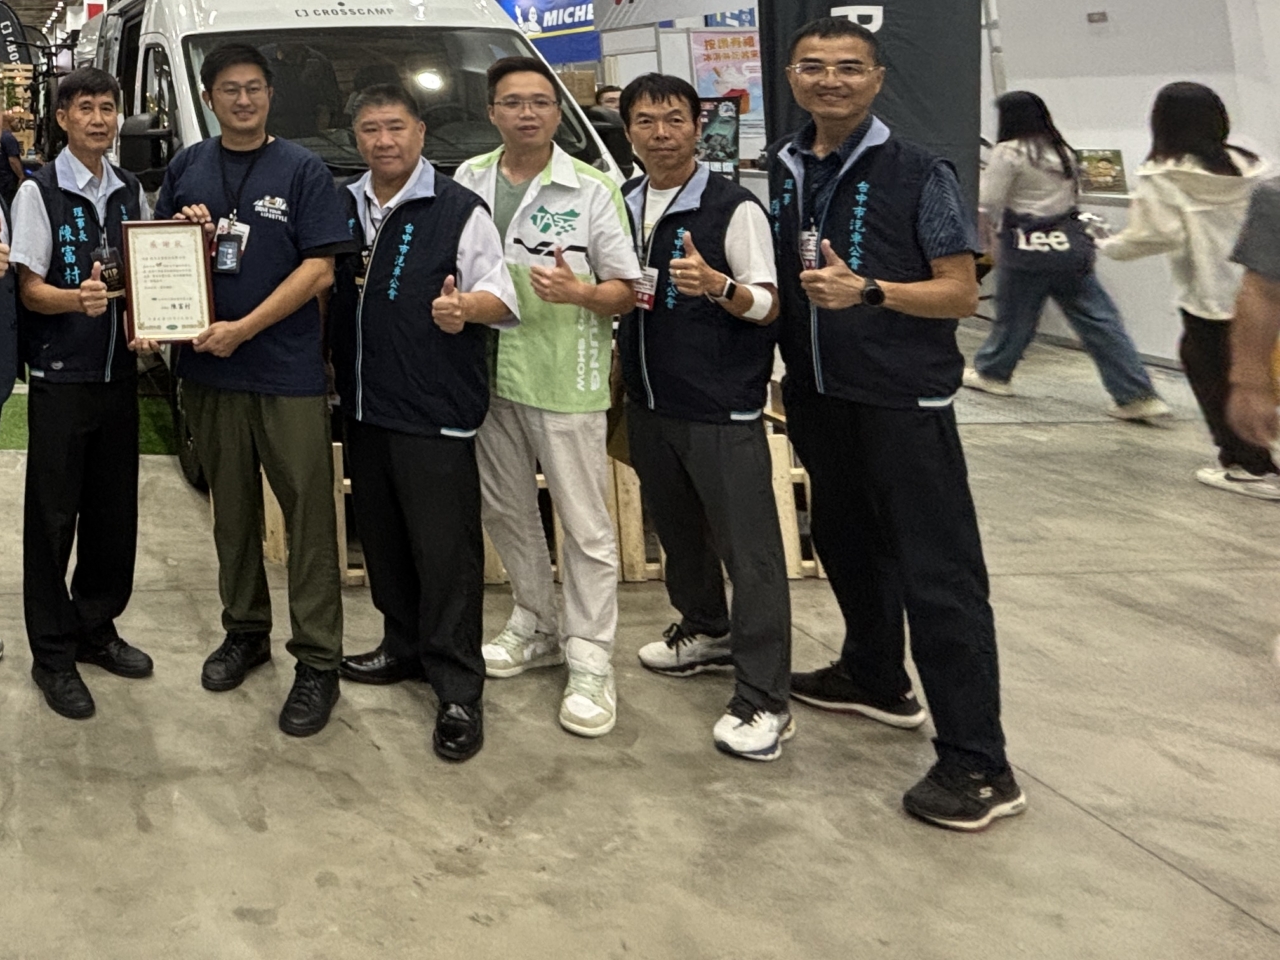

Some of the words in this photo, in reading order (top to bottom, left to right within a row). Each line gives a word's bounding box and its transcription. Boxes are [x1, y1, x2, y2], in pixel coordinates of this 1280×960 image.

[313, 8, 394, 17] CROSSCAMP
[848, 181, 870, 270] 台中市汽車公會
[1017, 227, 1071, 252] Lee
[59, 224, 81, 284] 陳富村
[102, 268, 118, 279] VIP
[387, 223, 414, 300] 台中市汽車公會
